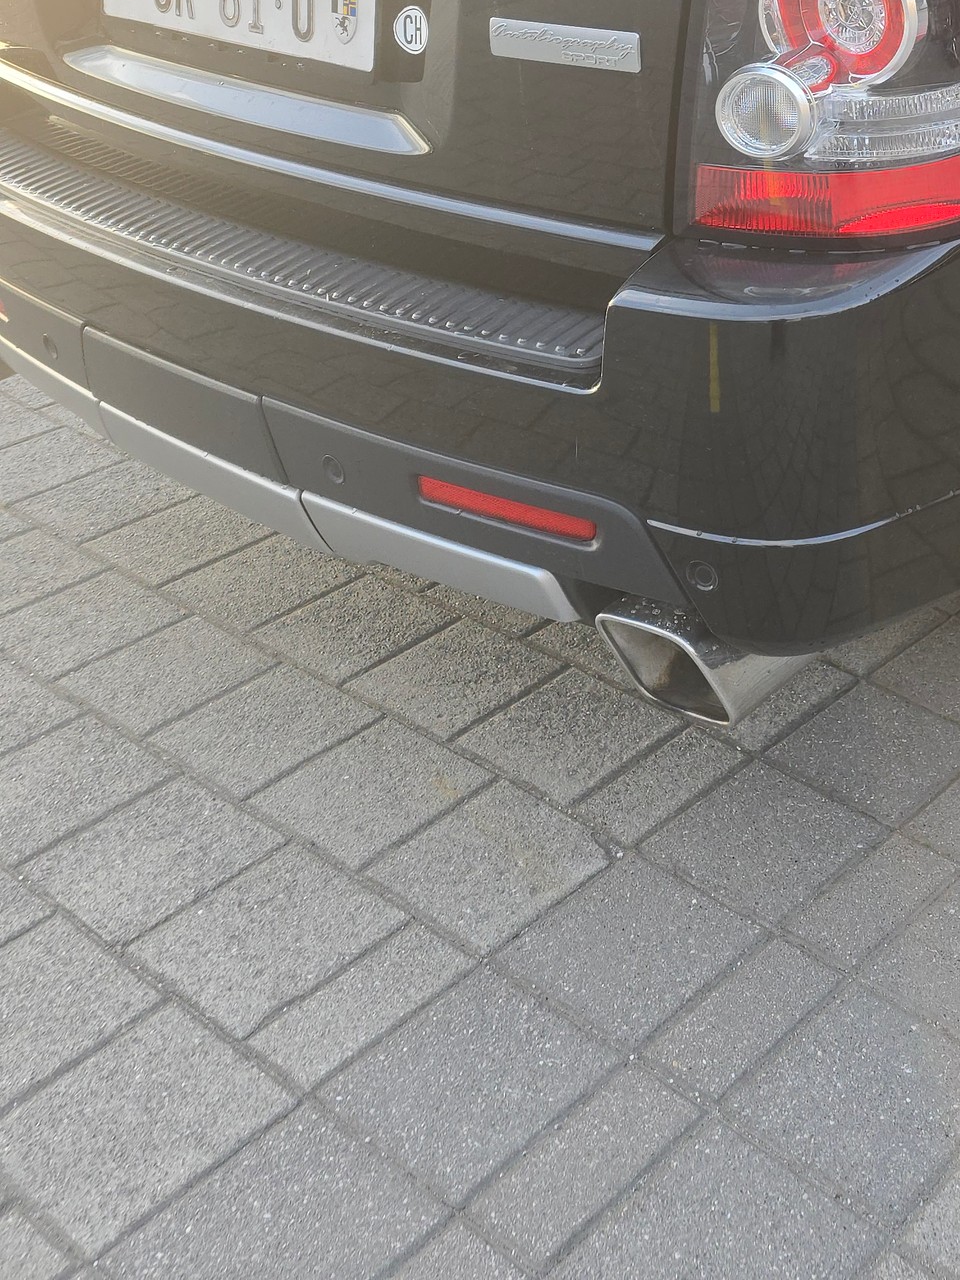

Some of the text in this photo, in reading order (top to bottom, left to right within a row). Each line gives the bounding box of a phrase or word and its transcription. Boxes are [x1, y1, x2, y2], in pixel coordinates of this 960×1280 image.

[402, 13, 423, 46] CH
[491, 22, 636, 60] Autobiography
[561, 50, 620, 68] SPORT
